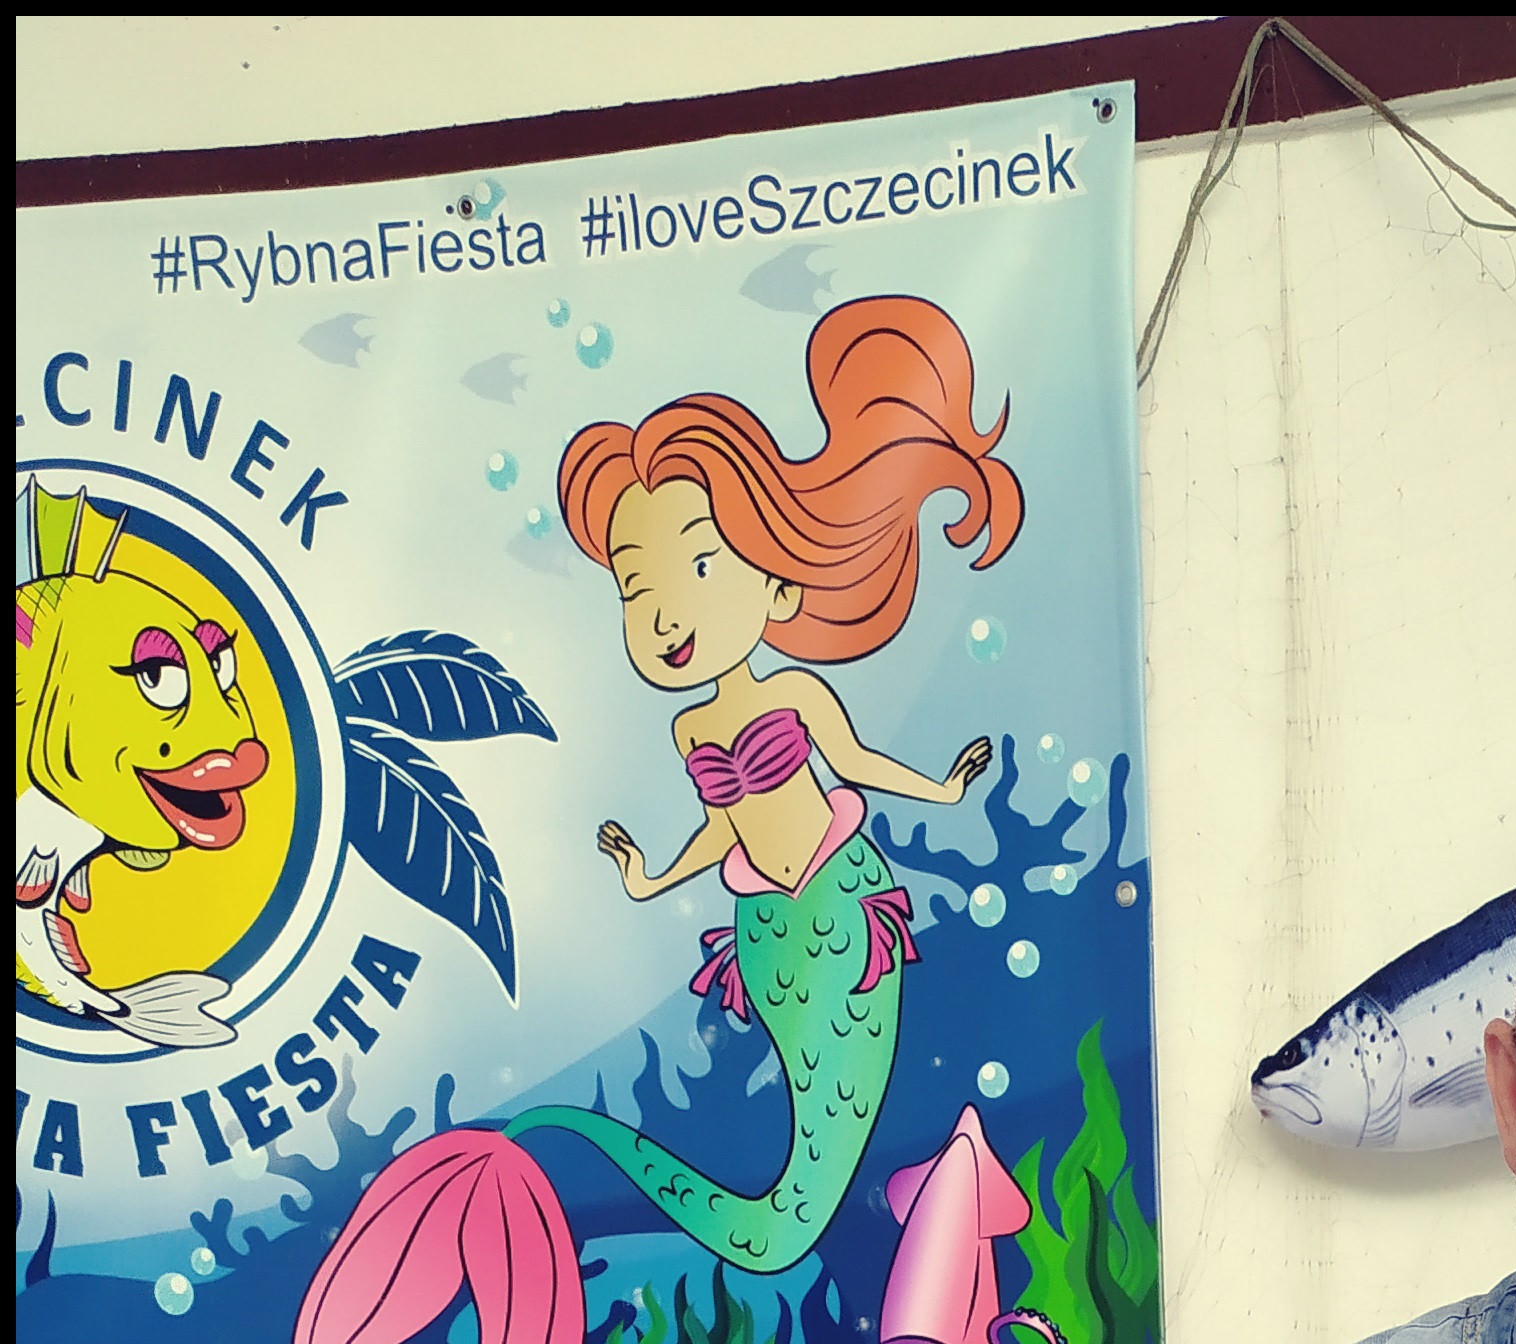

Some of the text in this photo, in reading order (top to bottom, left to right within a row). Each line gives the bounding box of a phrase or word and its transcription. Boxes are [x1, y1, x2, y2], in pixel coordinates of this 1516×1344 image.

[150, 133, 1077, 305] #RybnaFiesta #iloveSzczecinek
[16, 351, 349, 549] CINEK
[125, 933, 422, 1178] FIESTA
